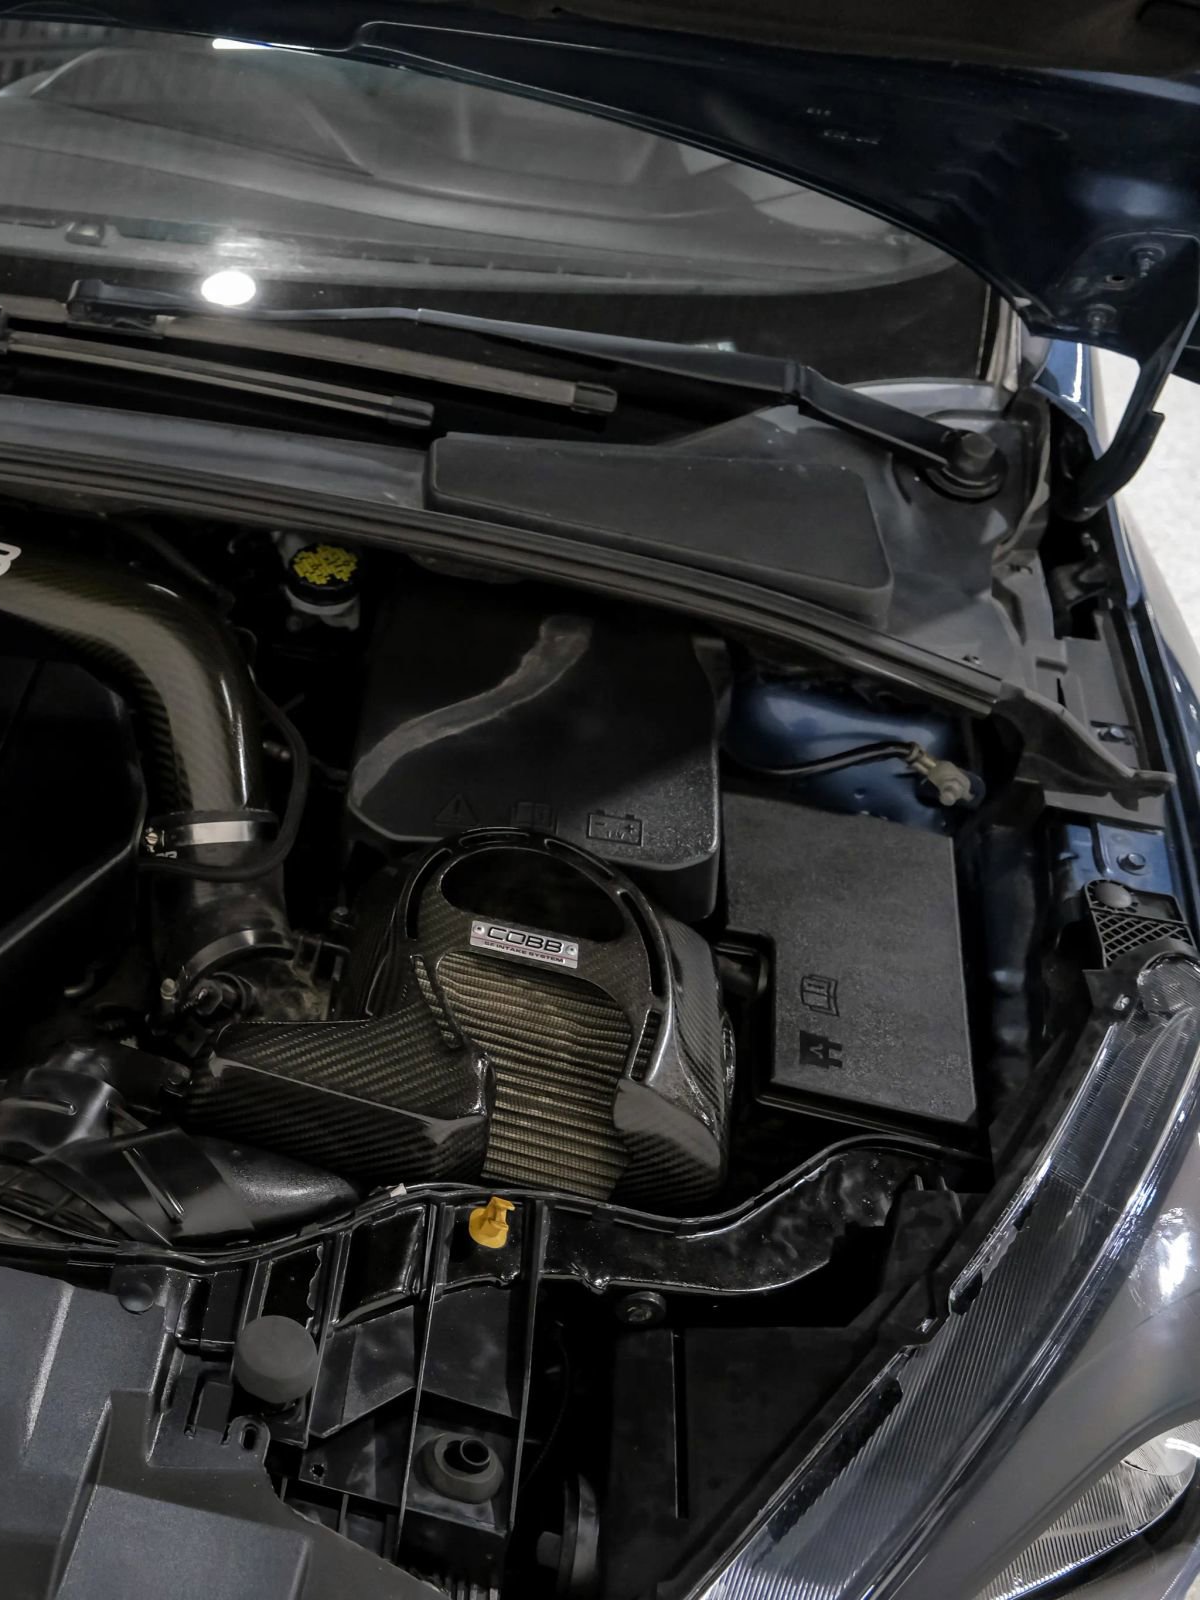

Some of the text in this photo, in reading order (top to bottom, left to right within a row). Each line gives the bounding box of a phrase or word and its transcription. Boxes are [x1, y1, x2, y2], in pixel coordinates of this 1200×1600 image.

[487, 926, 563, 953] COBB
[496, 943, 527, 955] INTAKE
[528, 951, 564, 963] SYSTEM
